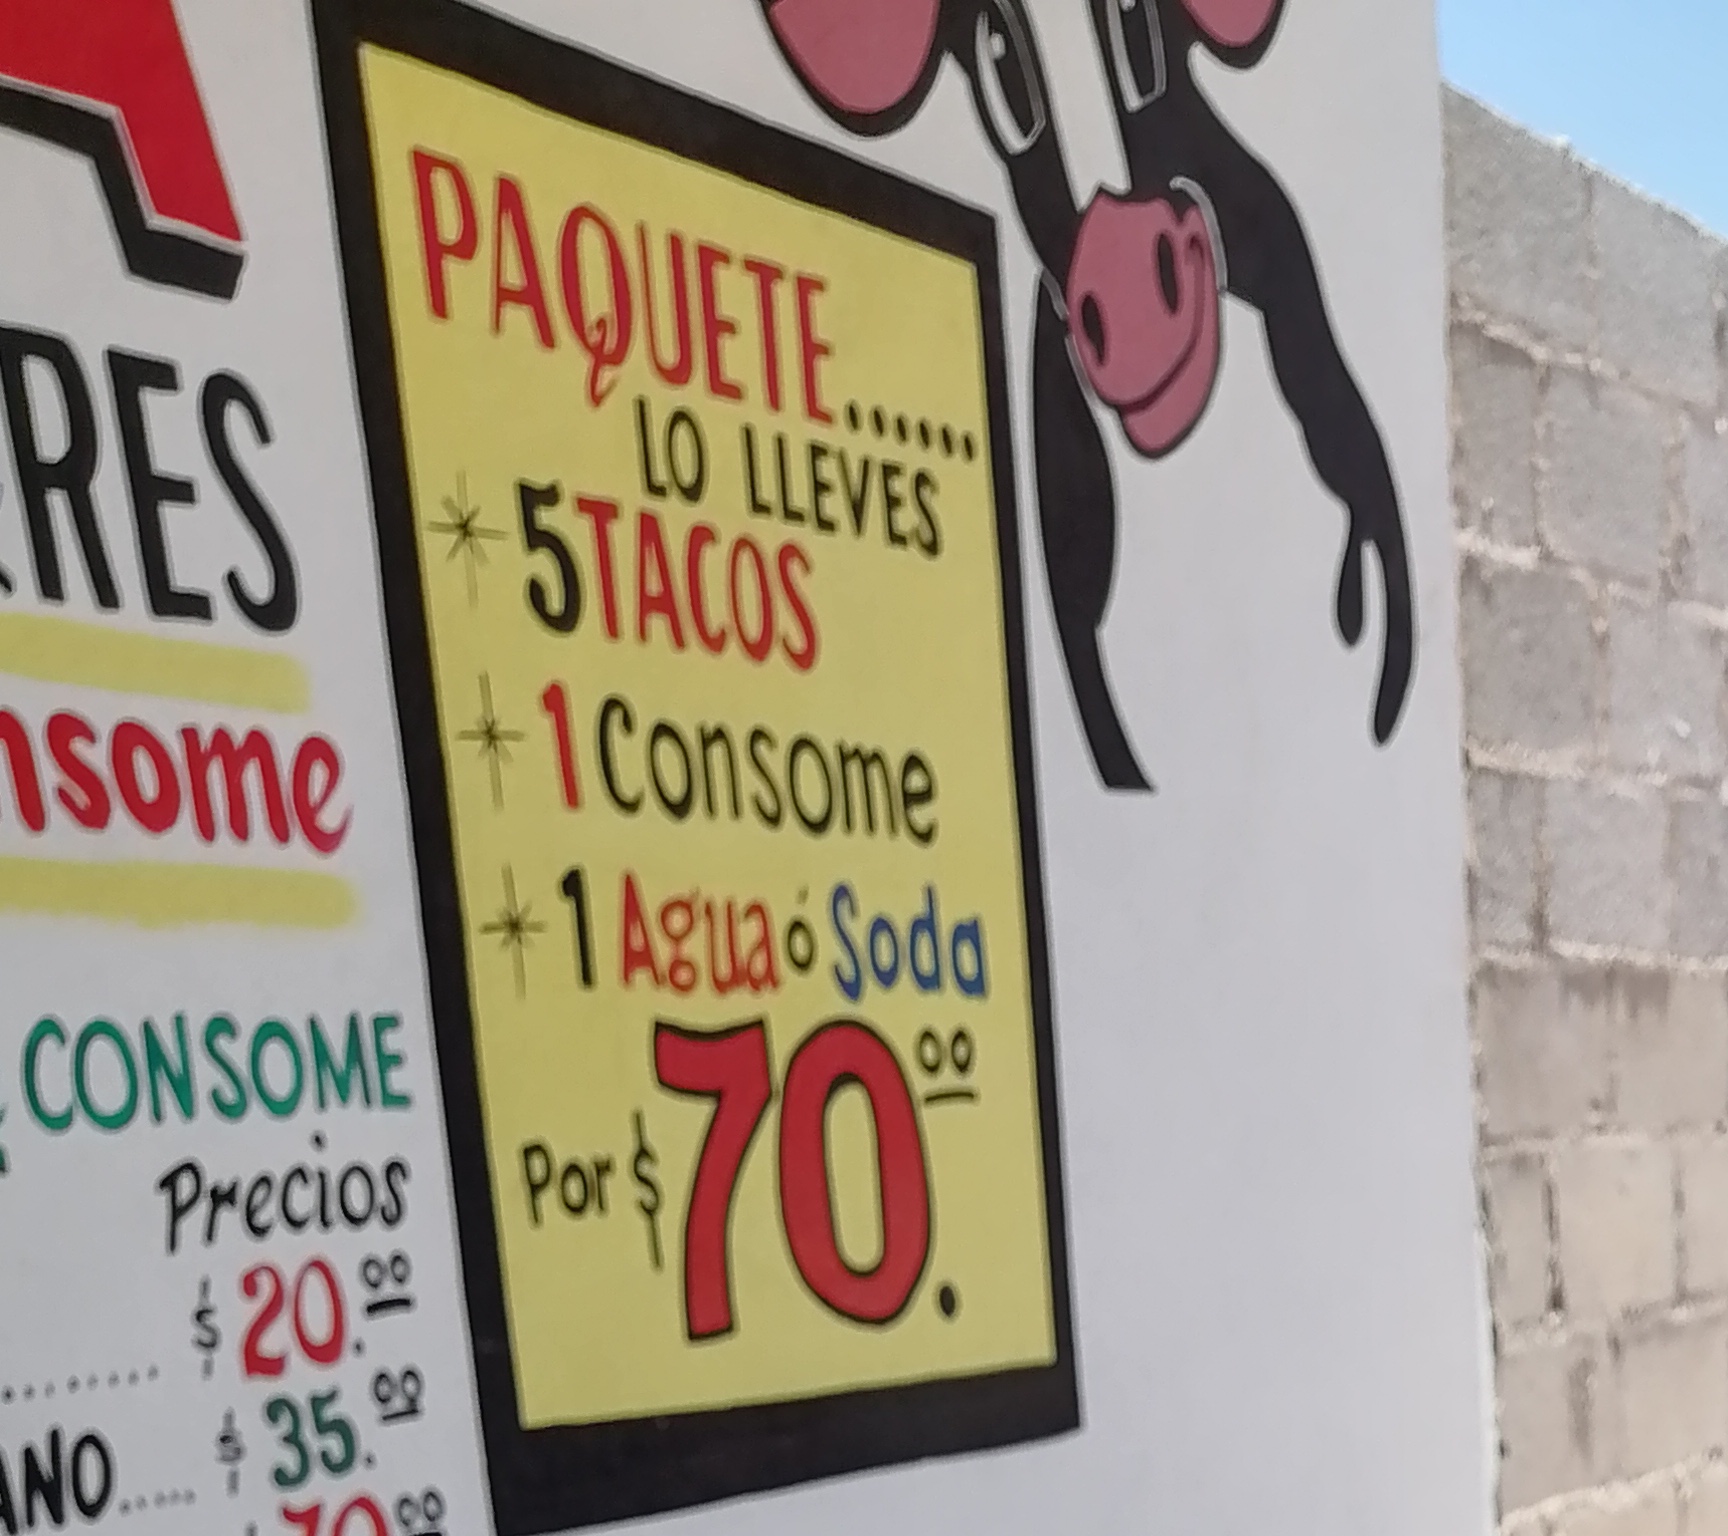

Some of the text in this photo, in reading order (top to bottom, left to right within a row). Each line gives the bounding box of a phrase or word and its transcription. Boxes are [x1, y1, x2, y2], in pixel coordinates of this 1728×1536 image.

[0, 325, 300, 633] RES
[634, 396, 944, 559] LO LLEVES
[540, 680, 939, 848] 1 Consome
[560, 864, 596, 990] 1
[621, 870, 782, 996] Agua
[829, 879, 988, 1002] Soda
[22, 1011, 414, 1131] CONSOME
[156, 1131, 412, 1256] Precios
[520, 1141, 614, 1228] Por
